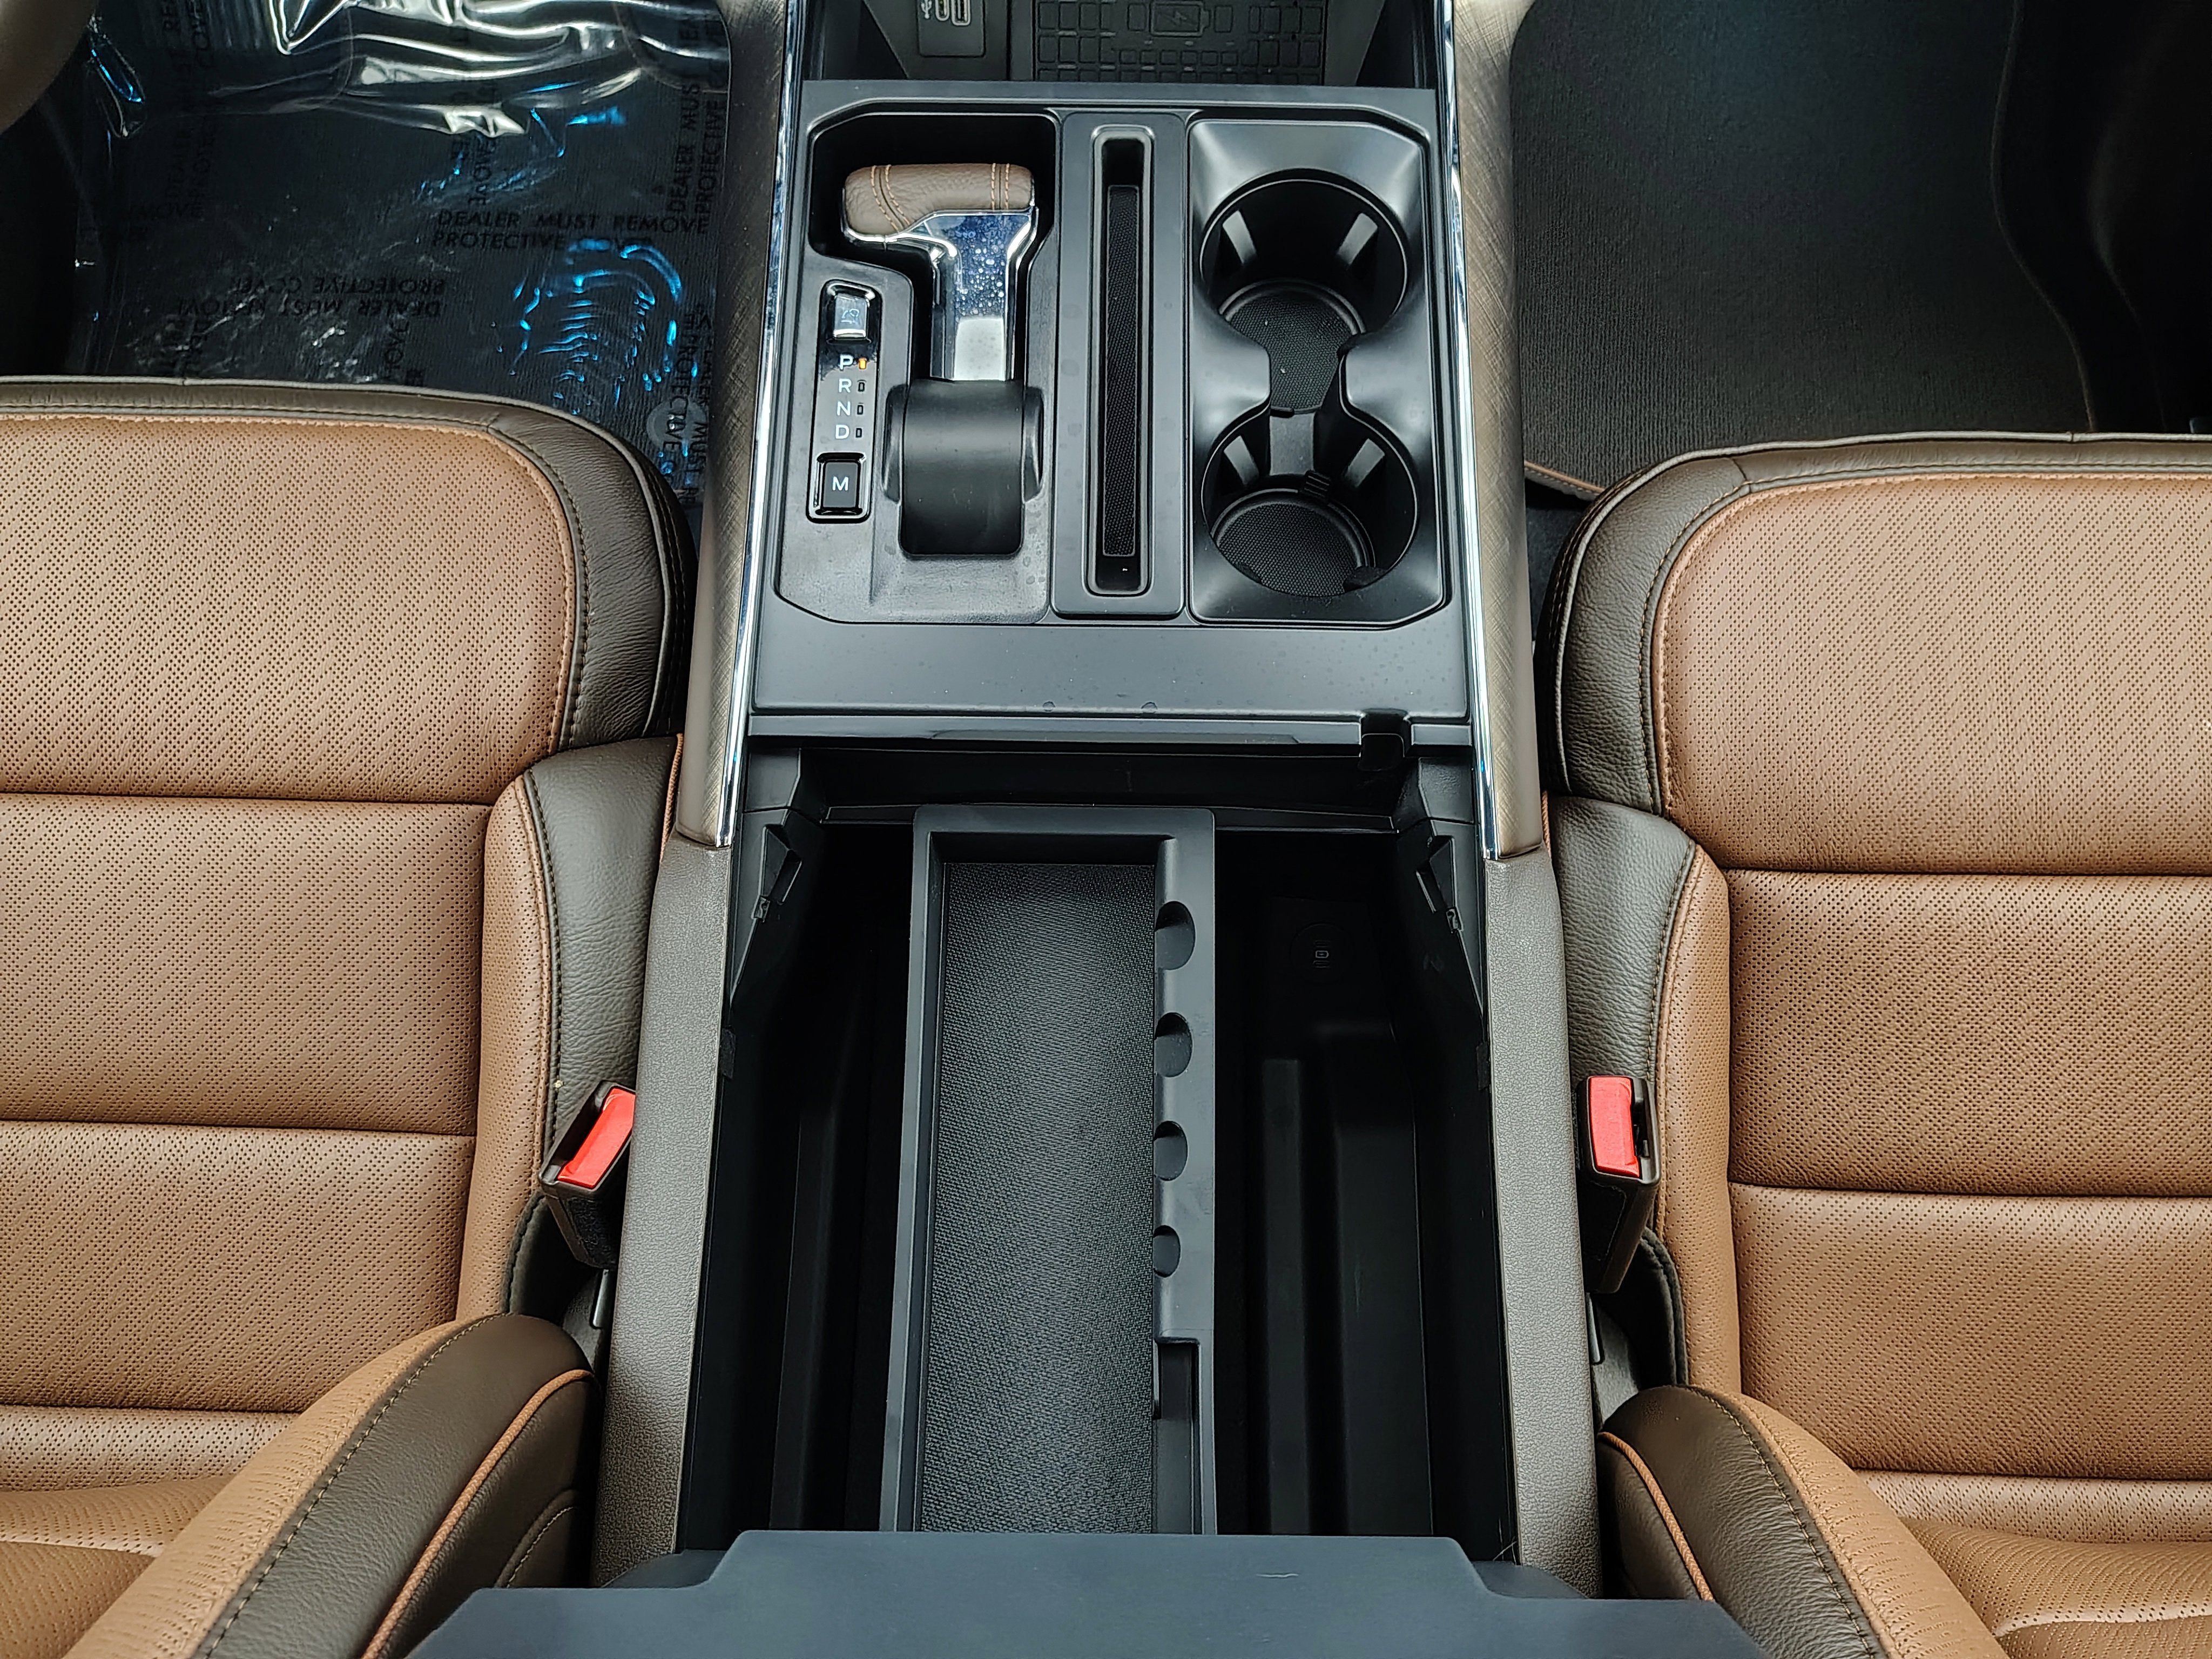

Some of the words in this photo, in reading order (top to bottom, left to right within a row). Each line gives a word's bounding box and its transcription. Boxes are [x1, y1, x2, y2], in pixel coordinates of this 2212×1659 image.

[438, 208, 520, 227] DEALER
[536, 212, 600, 231] MUST
[613, 214, 710, 235] REMOVE
[433, 231, 565, 250] PROTECTIVE
[839, 354, 854, 370] P
[839, 378, 852, 393] R
[837, 401, 851, 416] N
[835, 424, 849, 439] D
[832, 476, 849, 491] M
